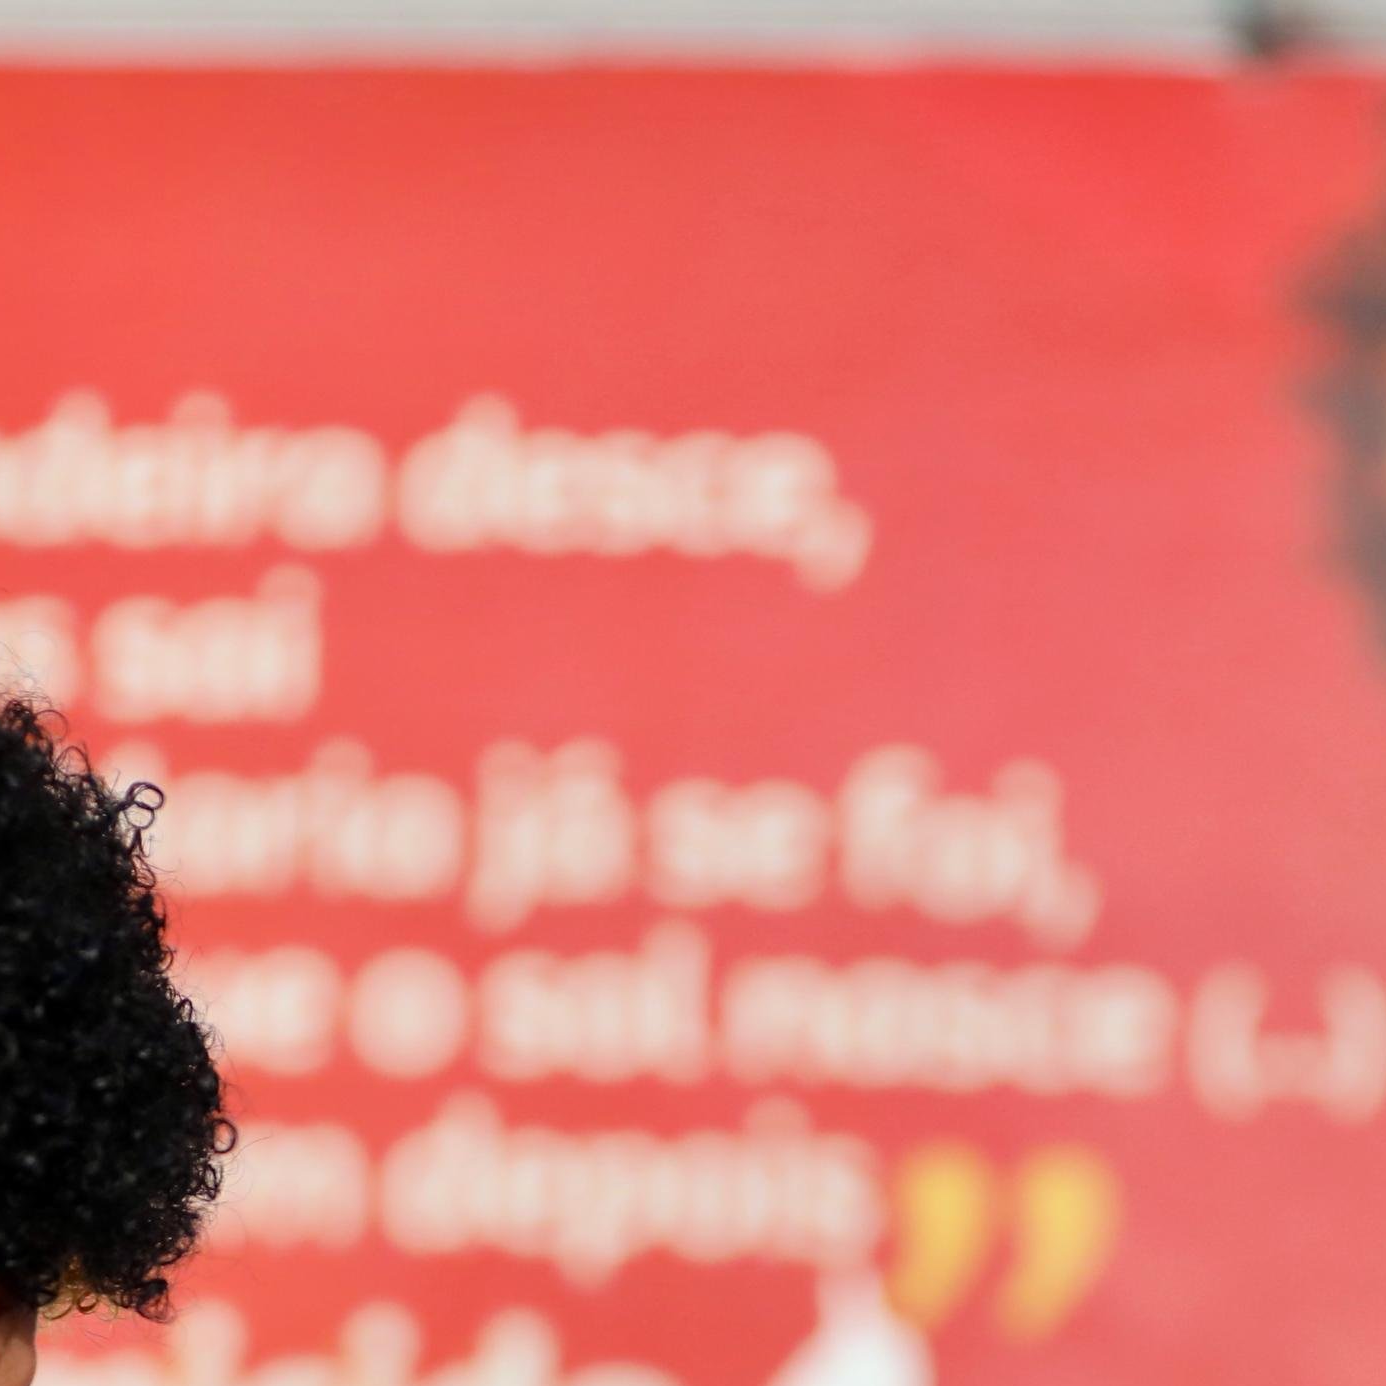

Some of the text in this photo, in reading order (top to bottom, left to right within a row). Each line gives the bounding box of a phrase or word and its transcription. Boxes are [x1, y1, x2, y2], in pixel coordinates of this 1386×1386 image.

[395, 398, 871, 588] desce,
[89, 567, 322, 723] sai
[466, 738, 634, 928] já
[643, 778, 829, 908] se
[838, 744, 1100, 945] foi,
[347, 947, 466, 1078] o
[475, 920, 711, 1082] sol
[714, 957, 1180, 1098] nasce
